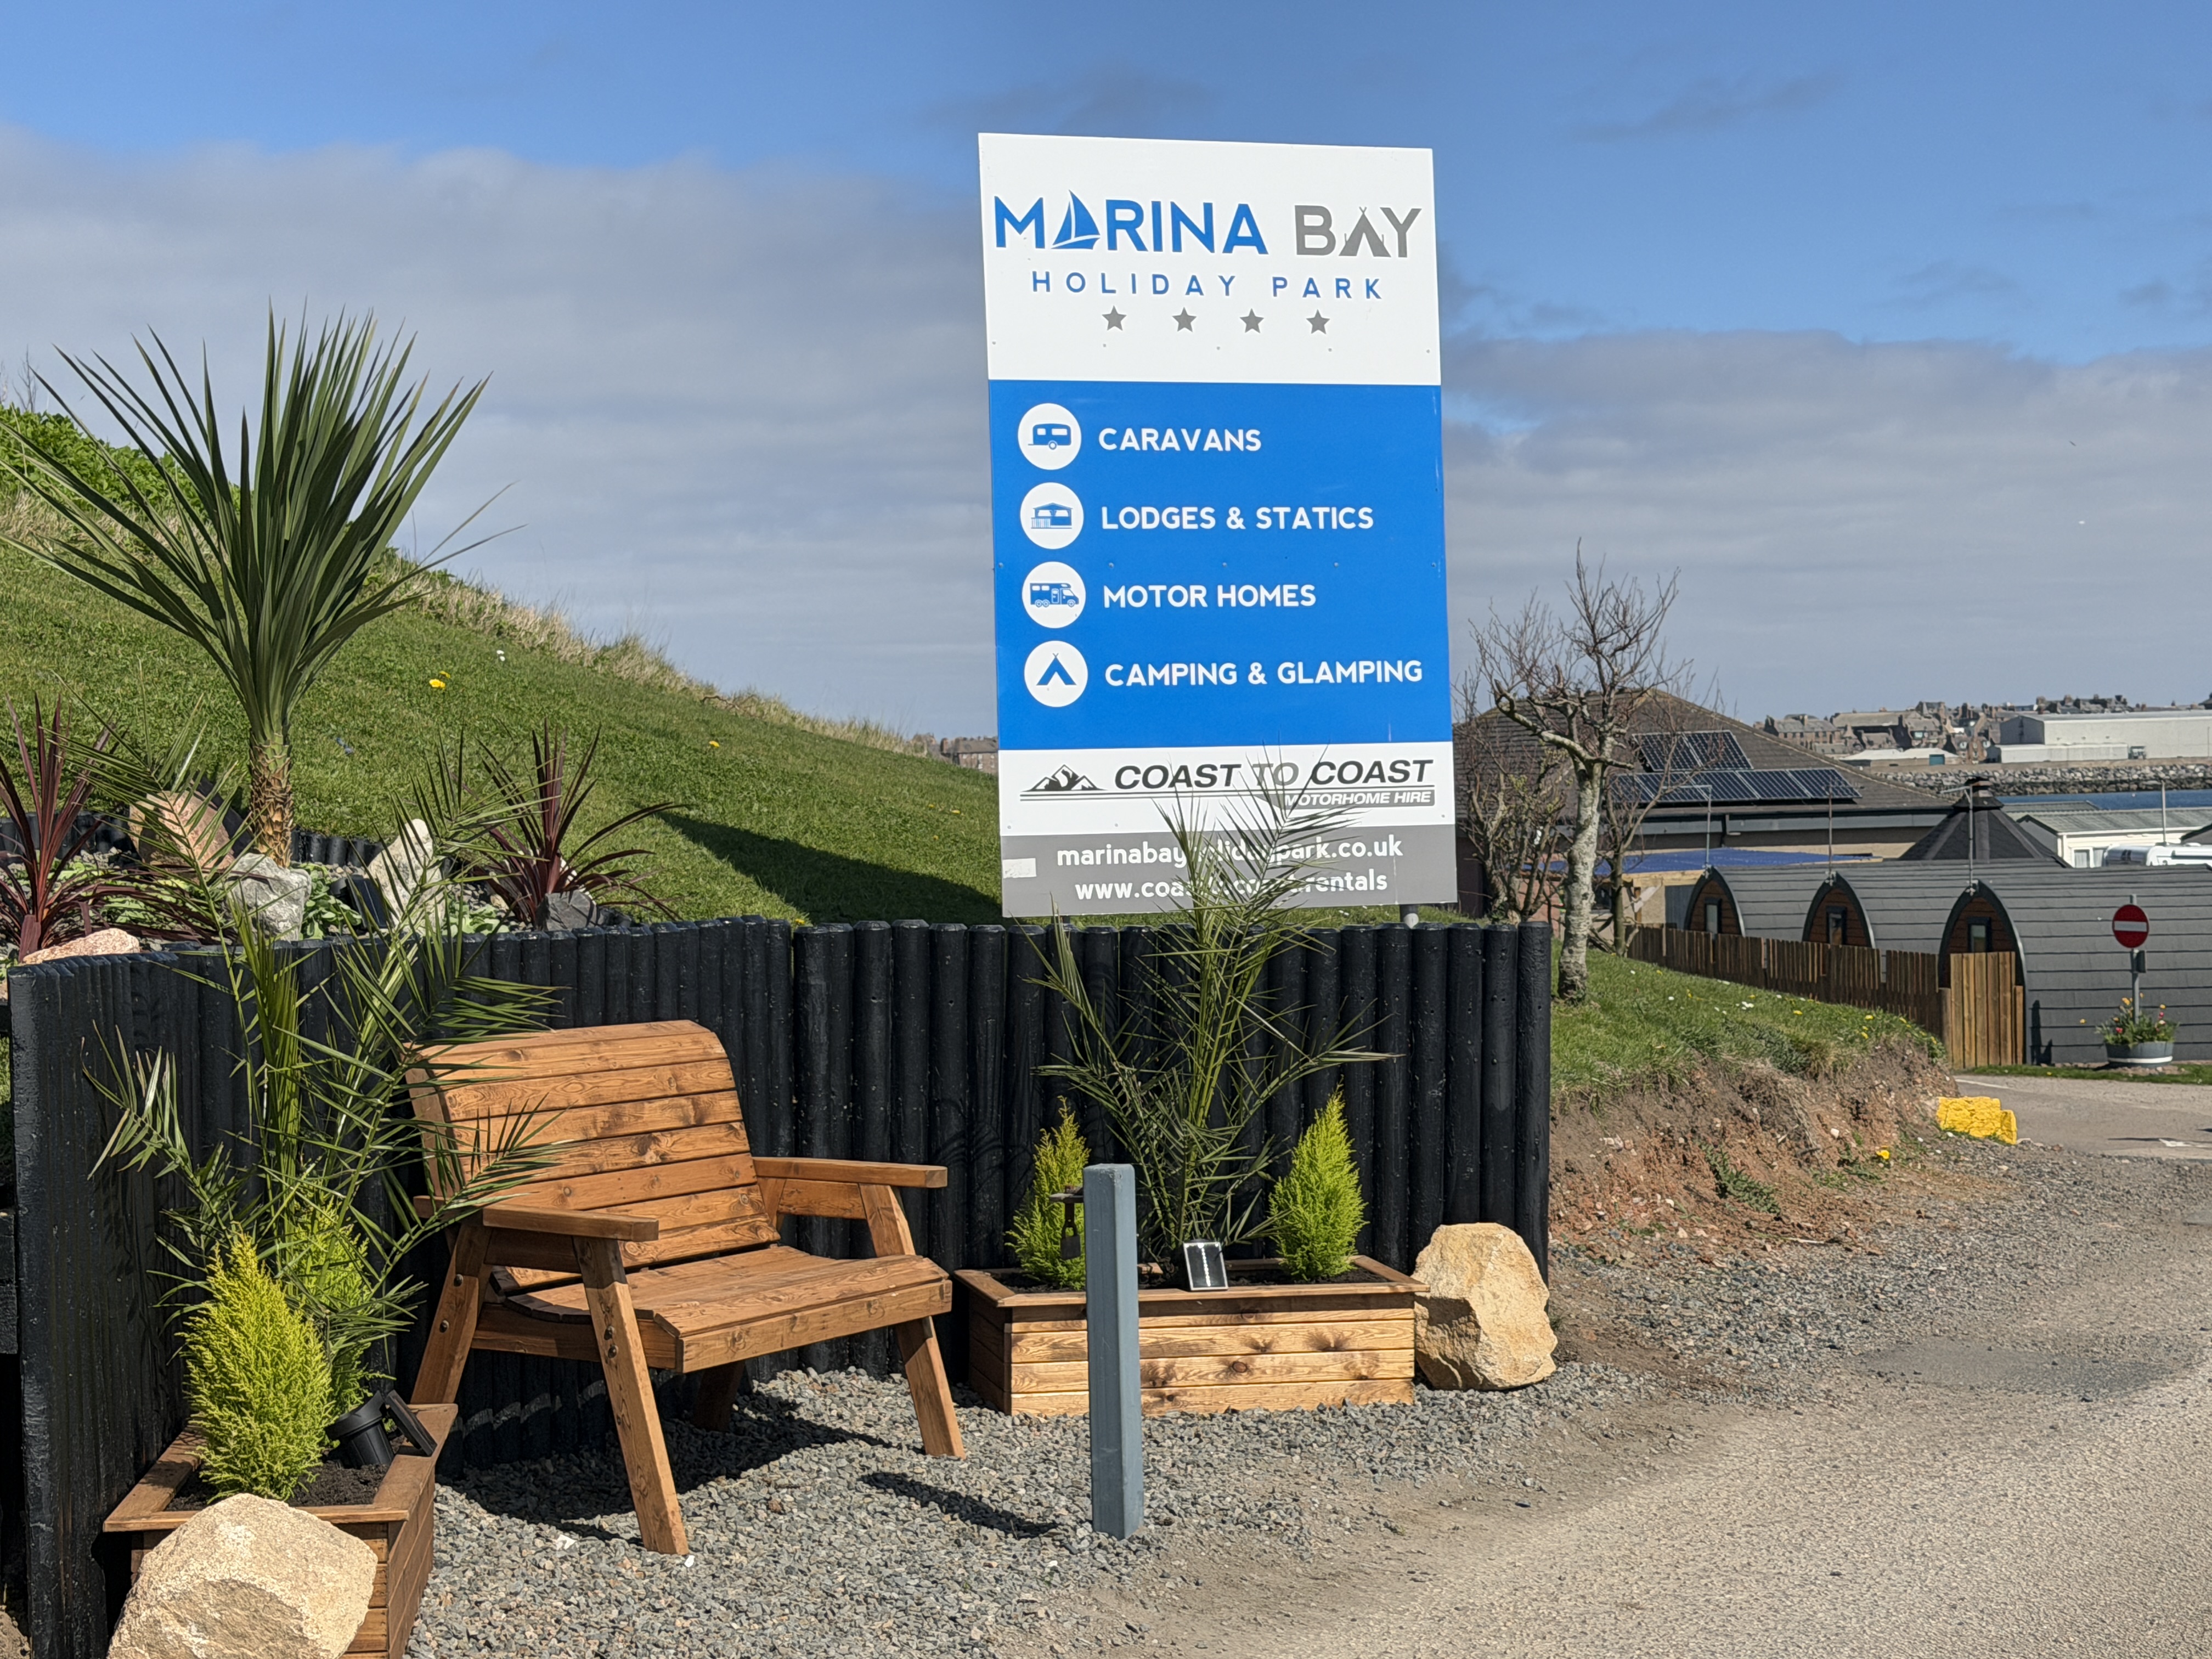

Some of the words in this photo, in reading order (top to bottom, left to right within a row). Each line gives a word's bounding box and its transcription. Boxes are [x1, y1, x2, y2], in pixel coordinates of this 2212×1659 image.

[994, 189, 1269, 255] MARINA
[1294, 205, 1422, 258] BAY
[1032, 270, 1236, 296] HOLIDAY
[1272, 276, 1382, 299] PARK
[1098, 428, 1262, 452] CARAVANS
[1102, 506, 1216, 529] LODGES
[1226, 506, 1246, 530] &
[1255, 506, 1374, 530] STATICS
[1103, 584, 1208, 608] MOTOR
[1217, 584, 1316, 607] HOMES
[1105, 662, 1238, 687] CAMPING
[1248, 663, 1268, 685] &
[1277, 660, 1423, 684] GLAMPING
[1115, 763, 1242, 789] COAST
[1252, 761, 1299, 786] TO
[1310, 759, 1434, 785] COAST
[1285, 792, 1391, 806] MOTORHOME
[1393, 791, 1432, 804] HIRE
